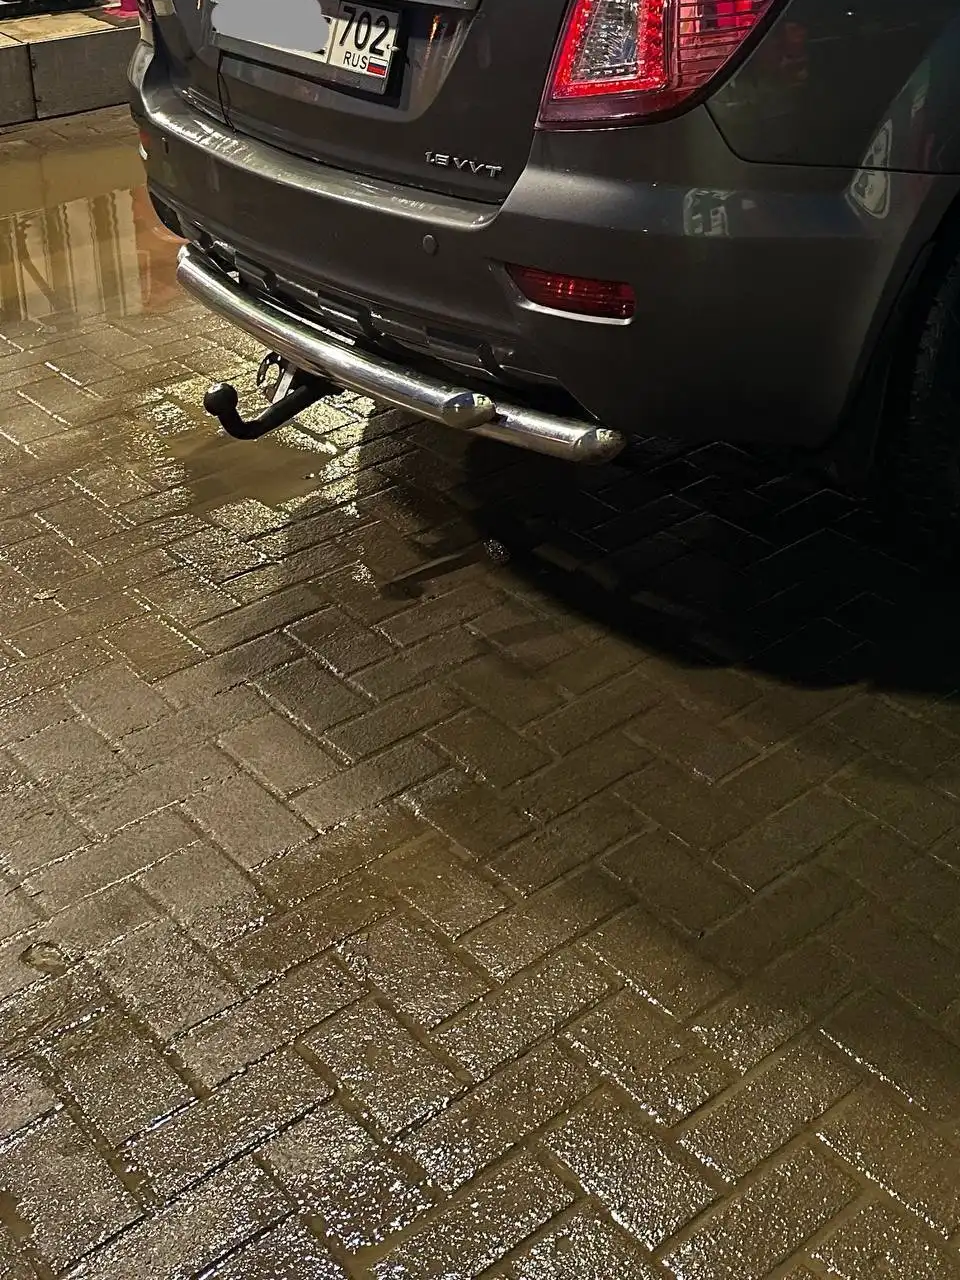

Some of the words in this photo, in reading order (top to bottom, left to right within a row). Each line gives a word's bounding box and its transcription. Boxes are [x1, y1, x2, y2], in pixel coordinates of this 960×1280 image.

[339, 6, 390, 56] 702
[343, 51, 368, 70] RUS
[453, 157, 503, 177] VVT
